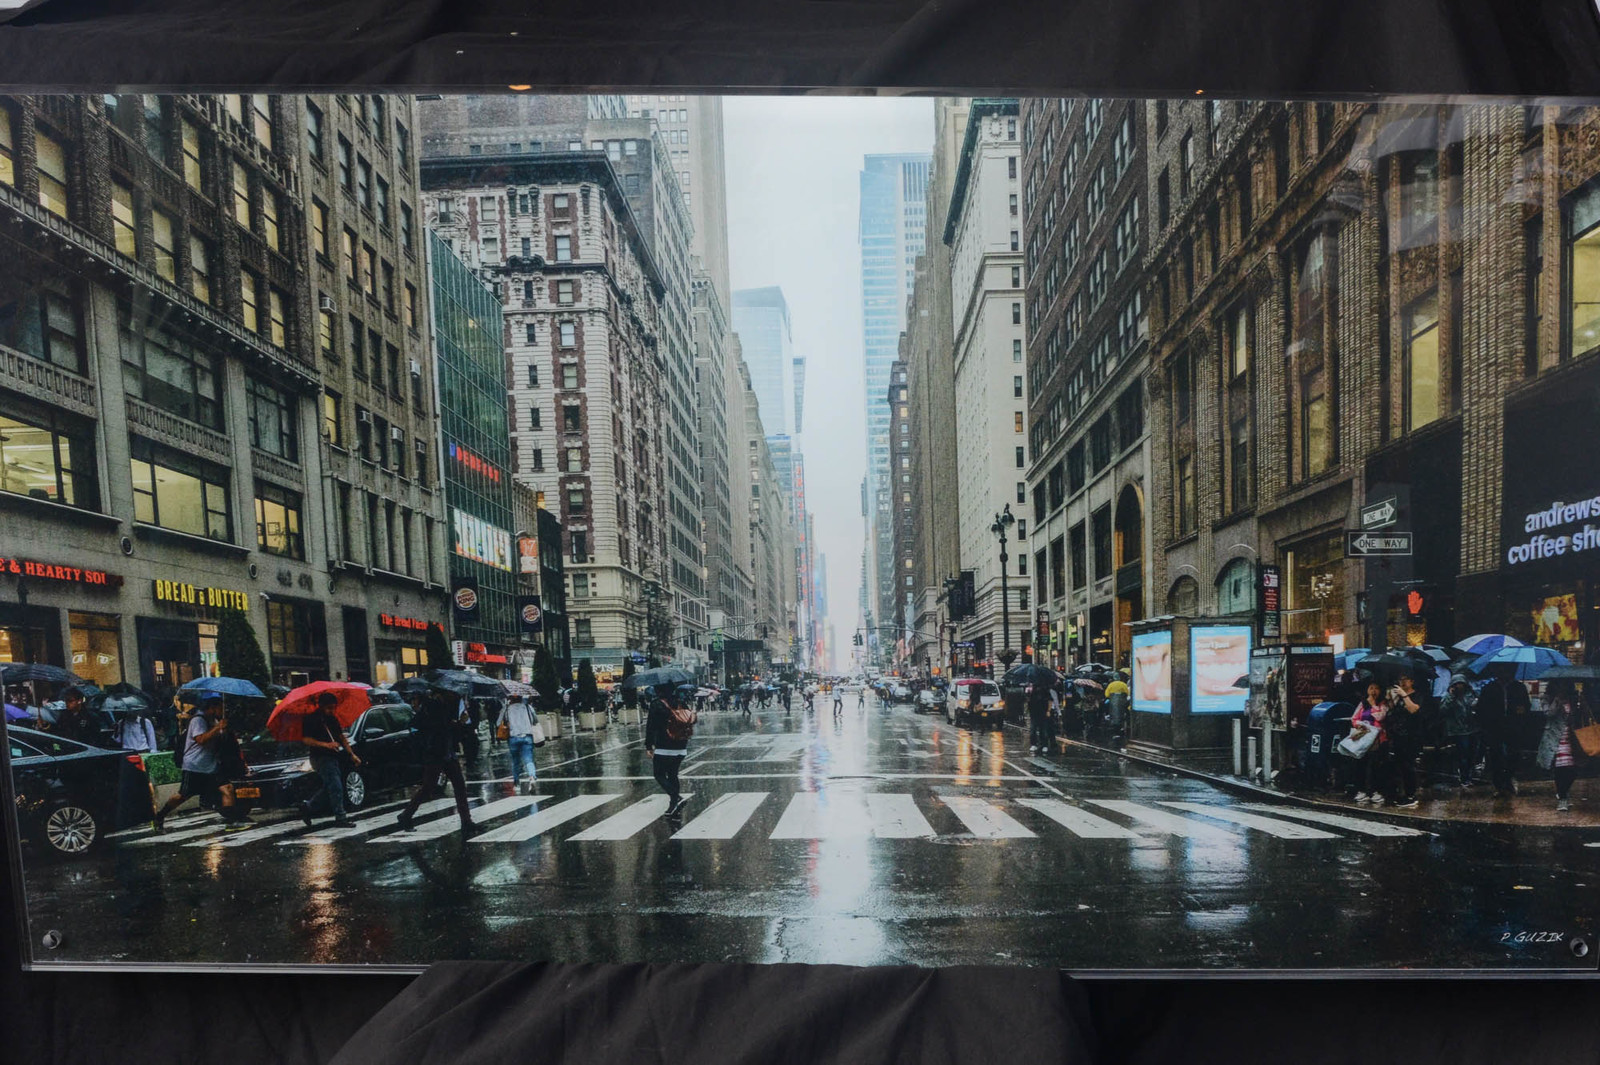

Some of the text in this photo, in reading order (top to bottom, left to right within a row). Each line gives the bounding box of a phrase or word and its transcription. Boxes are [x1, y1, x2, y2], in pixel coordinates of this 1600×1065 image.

[1366, 508, 1391, 522] ONE WAY
[1525, 496, 1600, 533] andrews
[1359, 539, 1403, 548] ONE WAY
[1508, 534, 1567, 564] coffee
[9, 559, 21, 573] &
[25, 562, 82, 581] HEARTY
[156, 579, 195, 604] BREAD
[208, 587, 248, 611] BUTTER
[381, 613, 392, 625] The
[1501, 931, 1564, 942] P GUZIK
